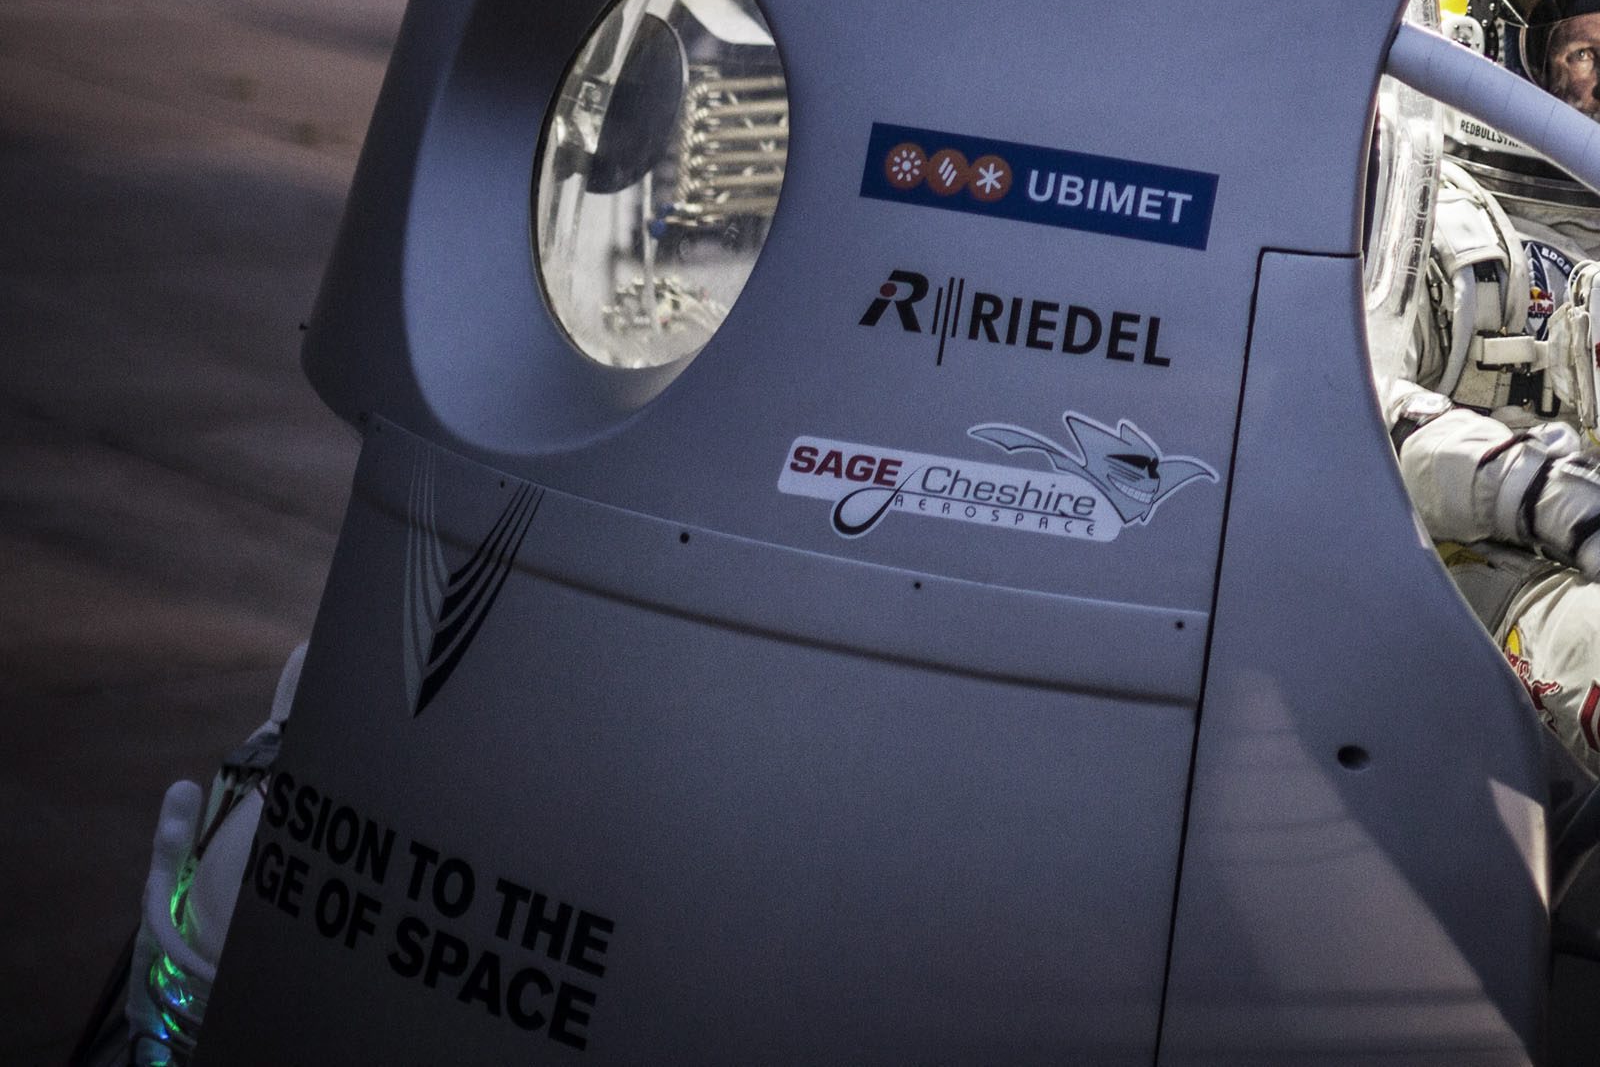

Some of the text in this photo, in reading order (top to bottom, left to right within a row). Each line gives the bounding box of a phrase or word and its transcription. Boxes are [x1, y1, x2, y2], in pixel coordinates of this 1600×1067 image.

[1026, 169, 1193, 224] UBIMET
[967, 291, 1172, 368] RIEDEL
[789, 445, 1097, 517] SAGE Cheshire
[894, 495, 1096, 536] AEROSPACE
[241, 838, 598, 1052] GE OF SPACE
[406, 840, 476, 919] TO
[495, 877, 615, 978] THE
